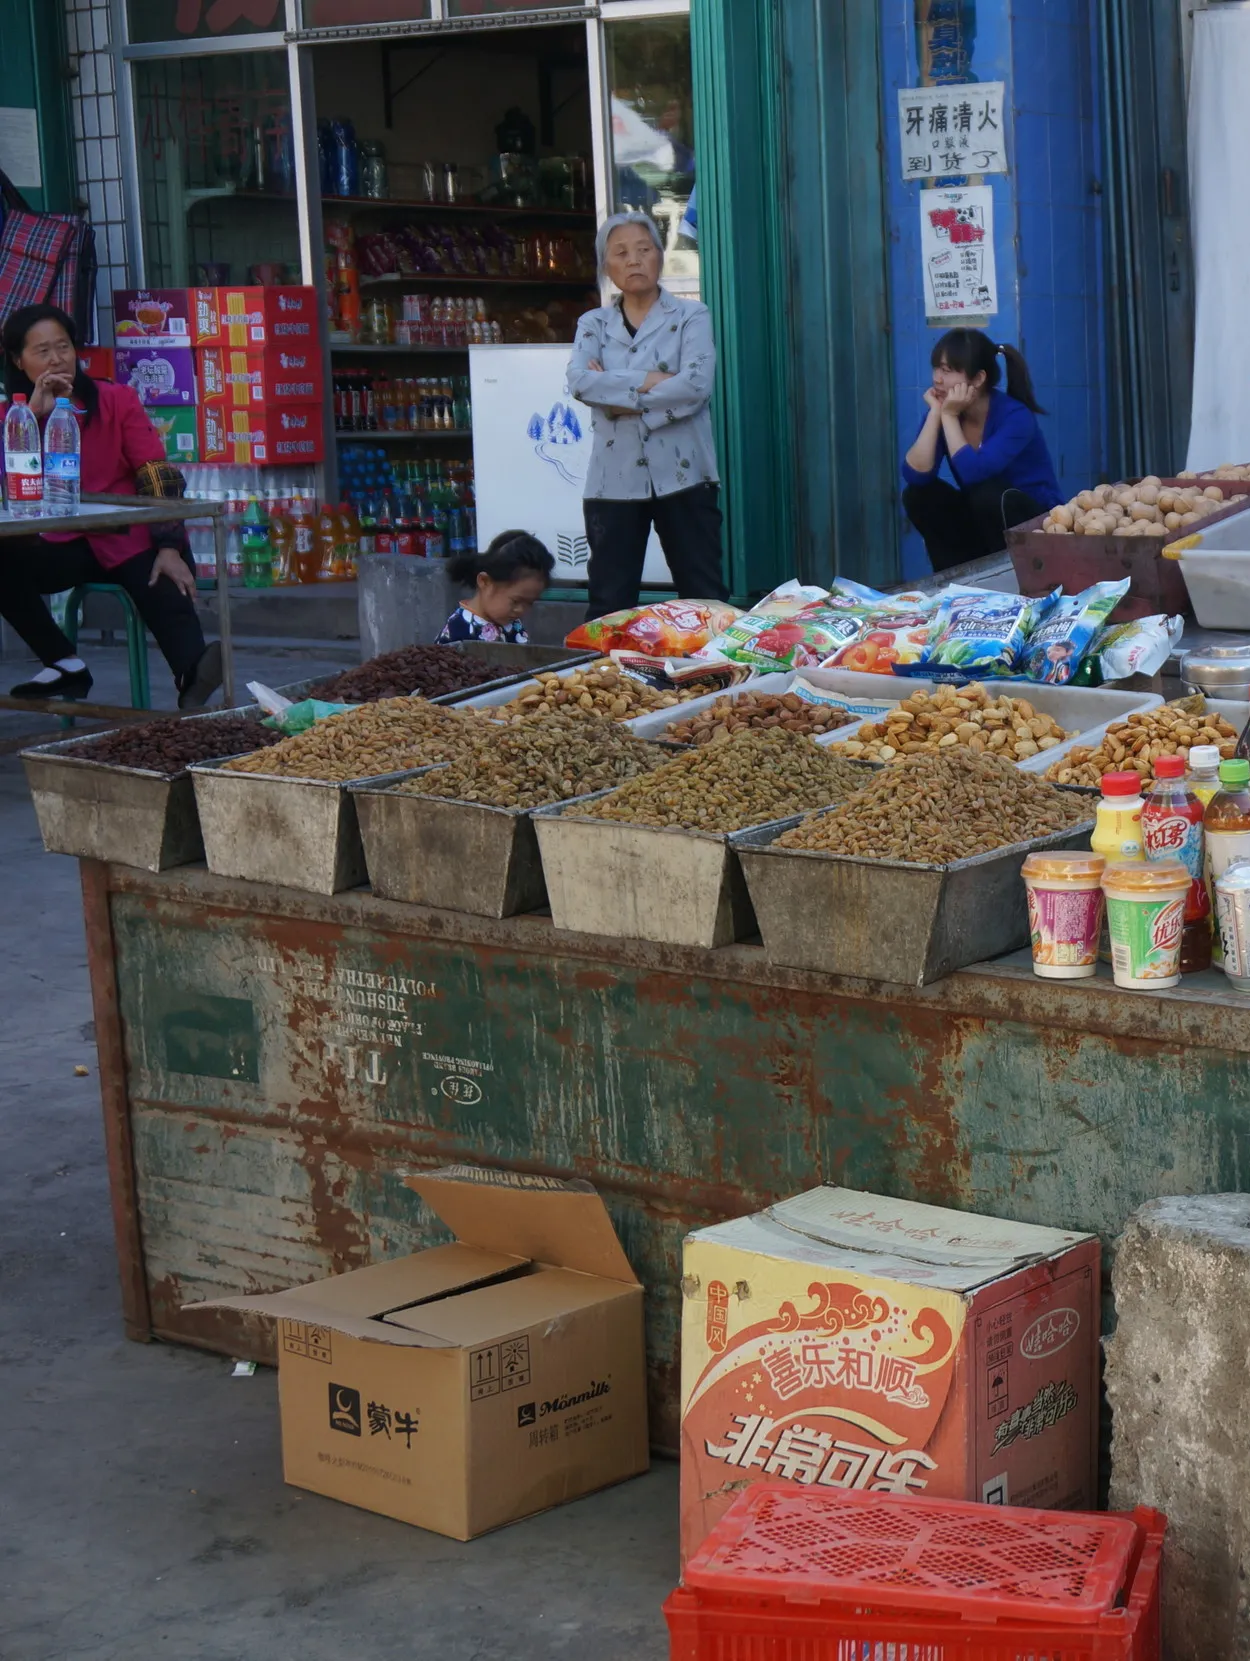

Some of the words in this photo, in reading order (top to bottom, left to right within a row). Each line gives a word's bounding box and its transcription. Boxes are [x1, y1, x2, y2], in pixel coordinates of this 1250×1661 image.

[906, 100, 998, 136] 牙痛清火
[907, 150, 999, 172] 到货了
[345, 989, 407, 1012] FUSHUN
[707, 1285, 728, 1350] 中国风
[1026, 1312, 1074, 1353] 娃哈哈
[763, 1342, 917, 1398] 喜乐和顺
[366, 1400, 419, 1450] 蒙牛
[705, 1414, 939, 1496] 非常可乐
